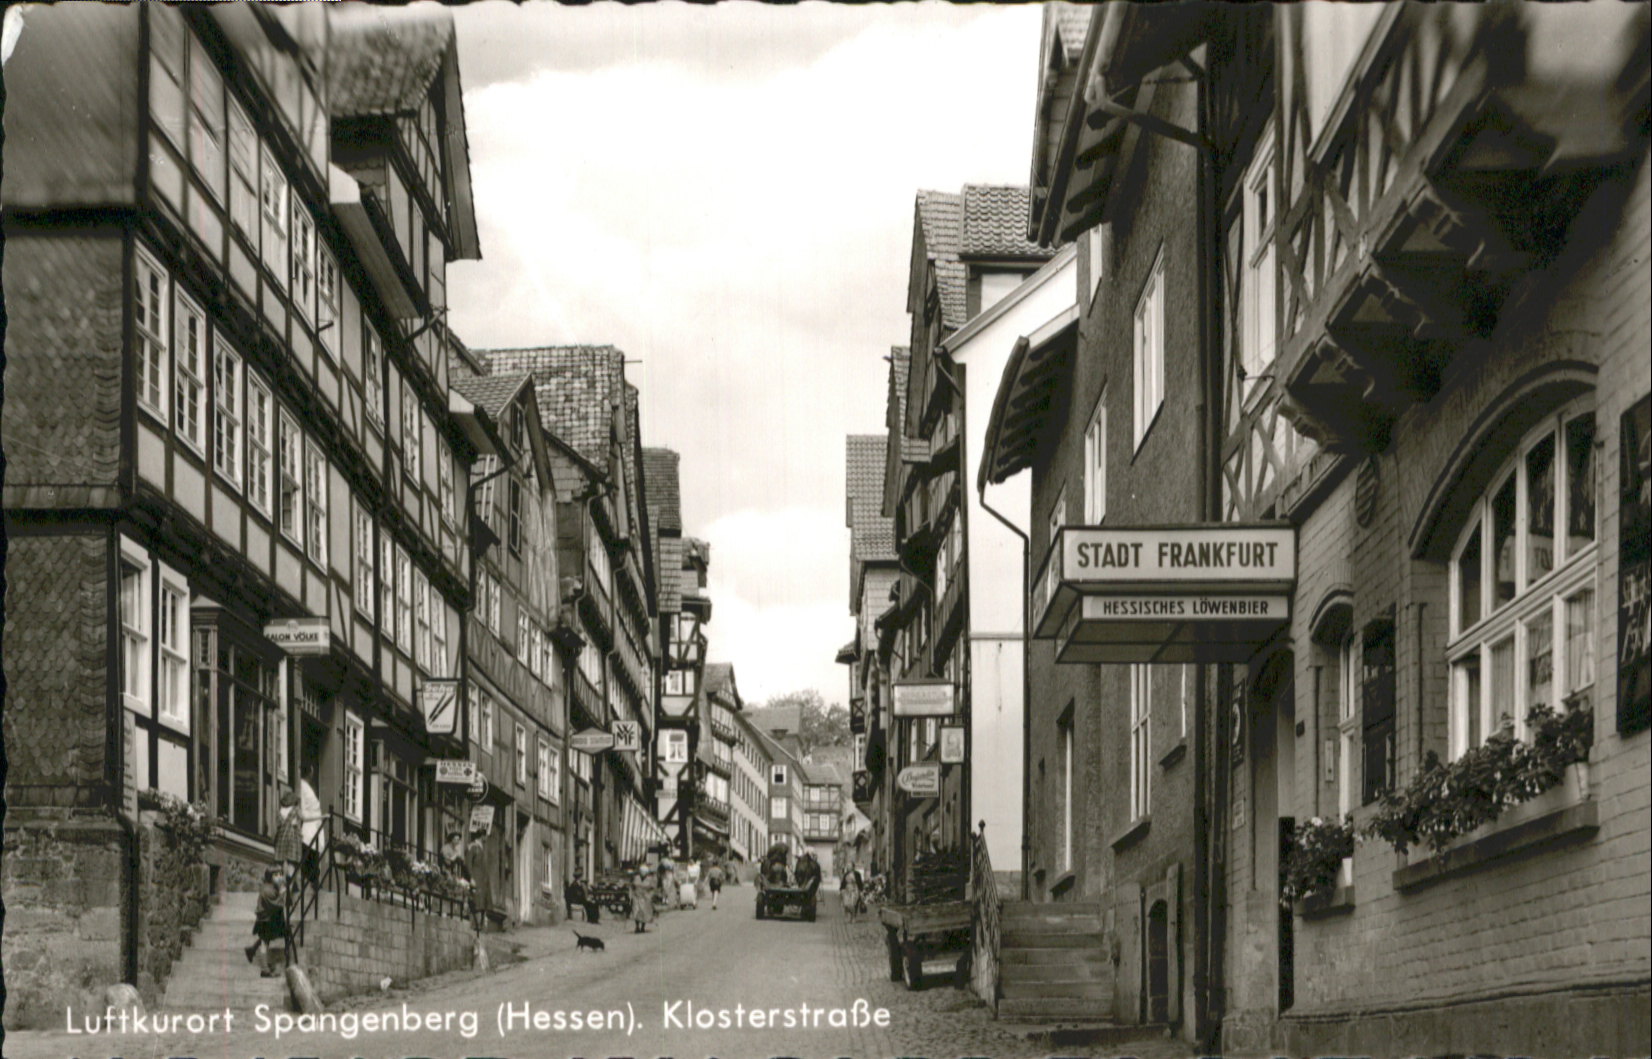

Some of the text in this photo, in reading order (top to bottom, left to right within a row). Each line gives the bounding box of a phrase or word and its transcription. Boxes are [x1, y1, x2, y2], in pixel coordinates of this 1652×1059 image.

[1077, 542, 1279, 568] STADT FRANKFURT
[1103, 598, 1269, 615] HESSISCHES LÖWENBIER
[616, 723, 635, 746] WMF
